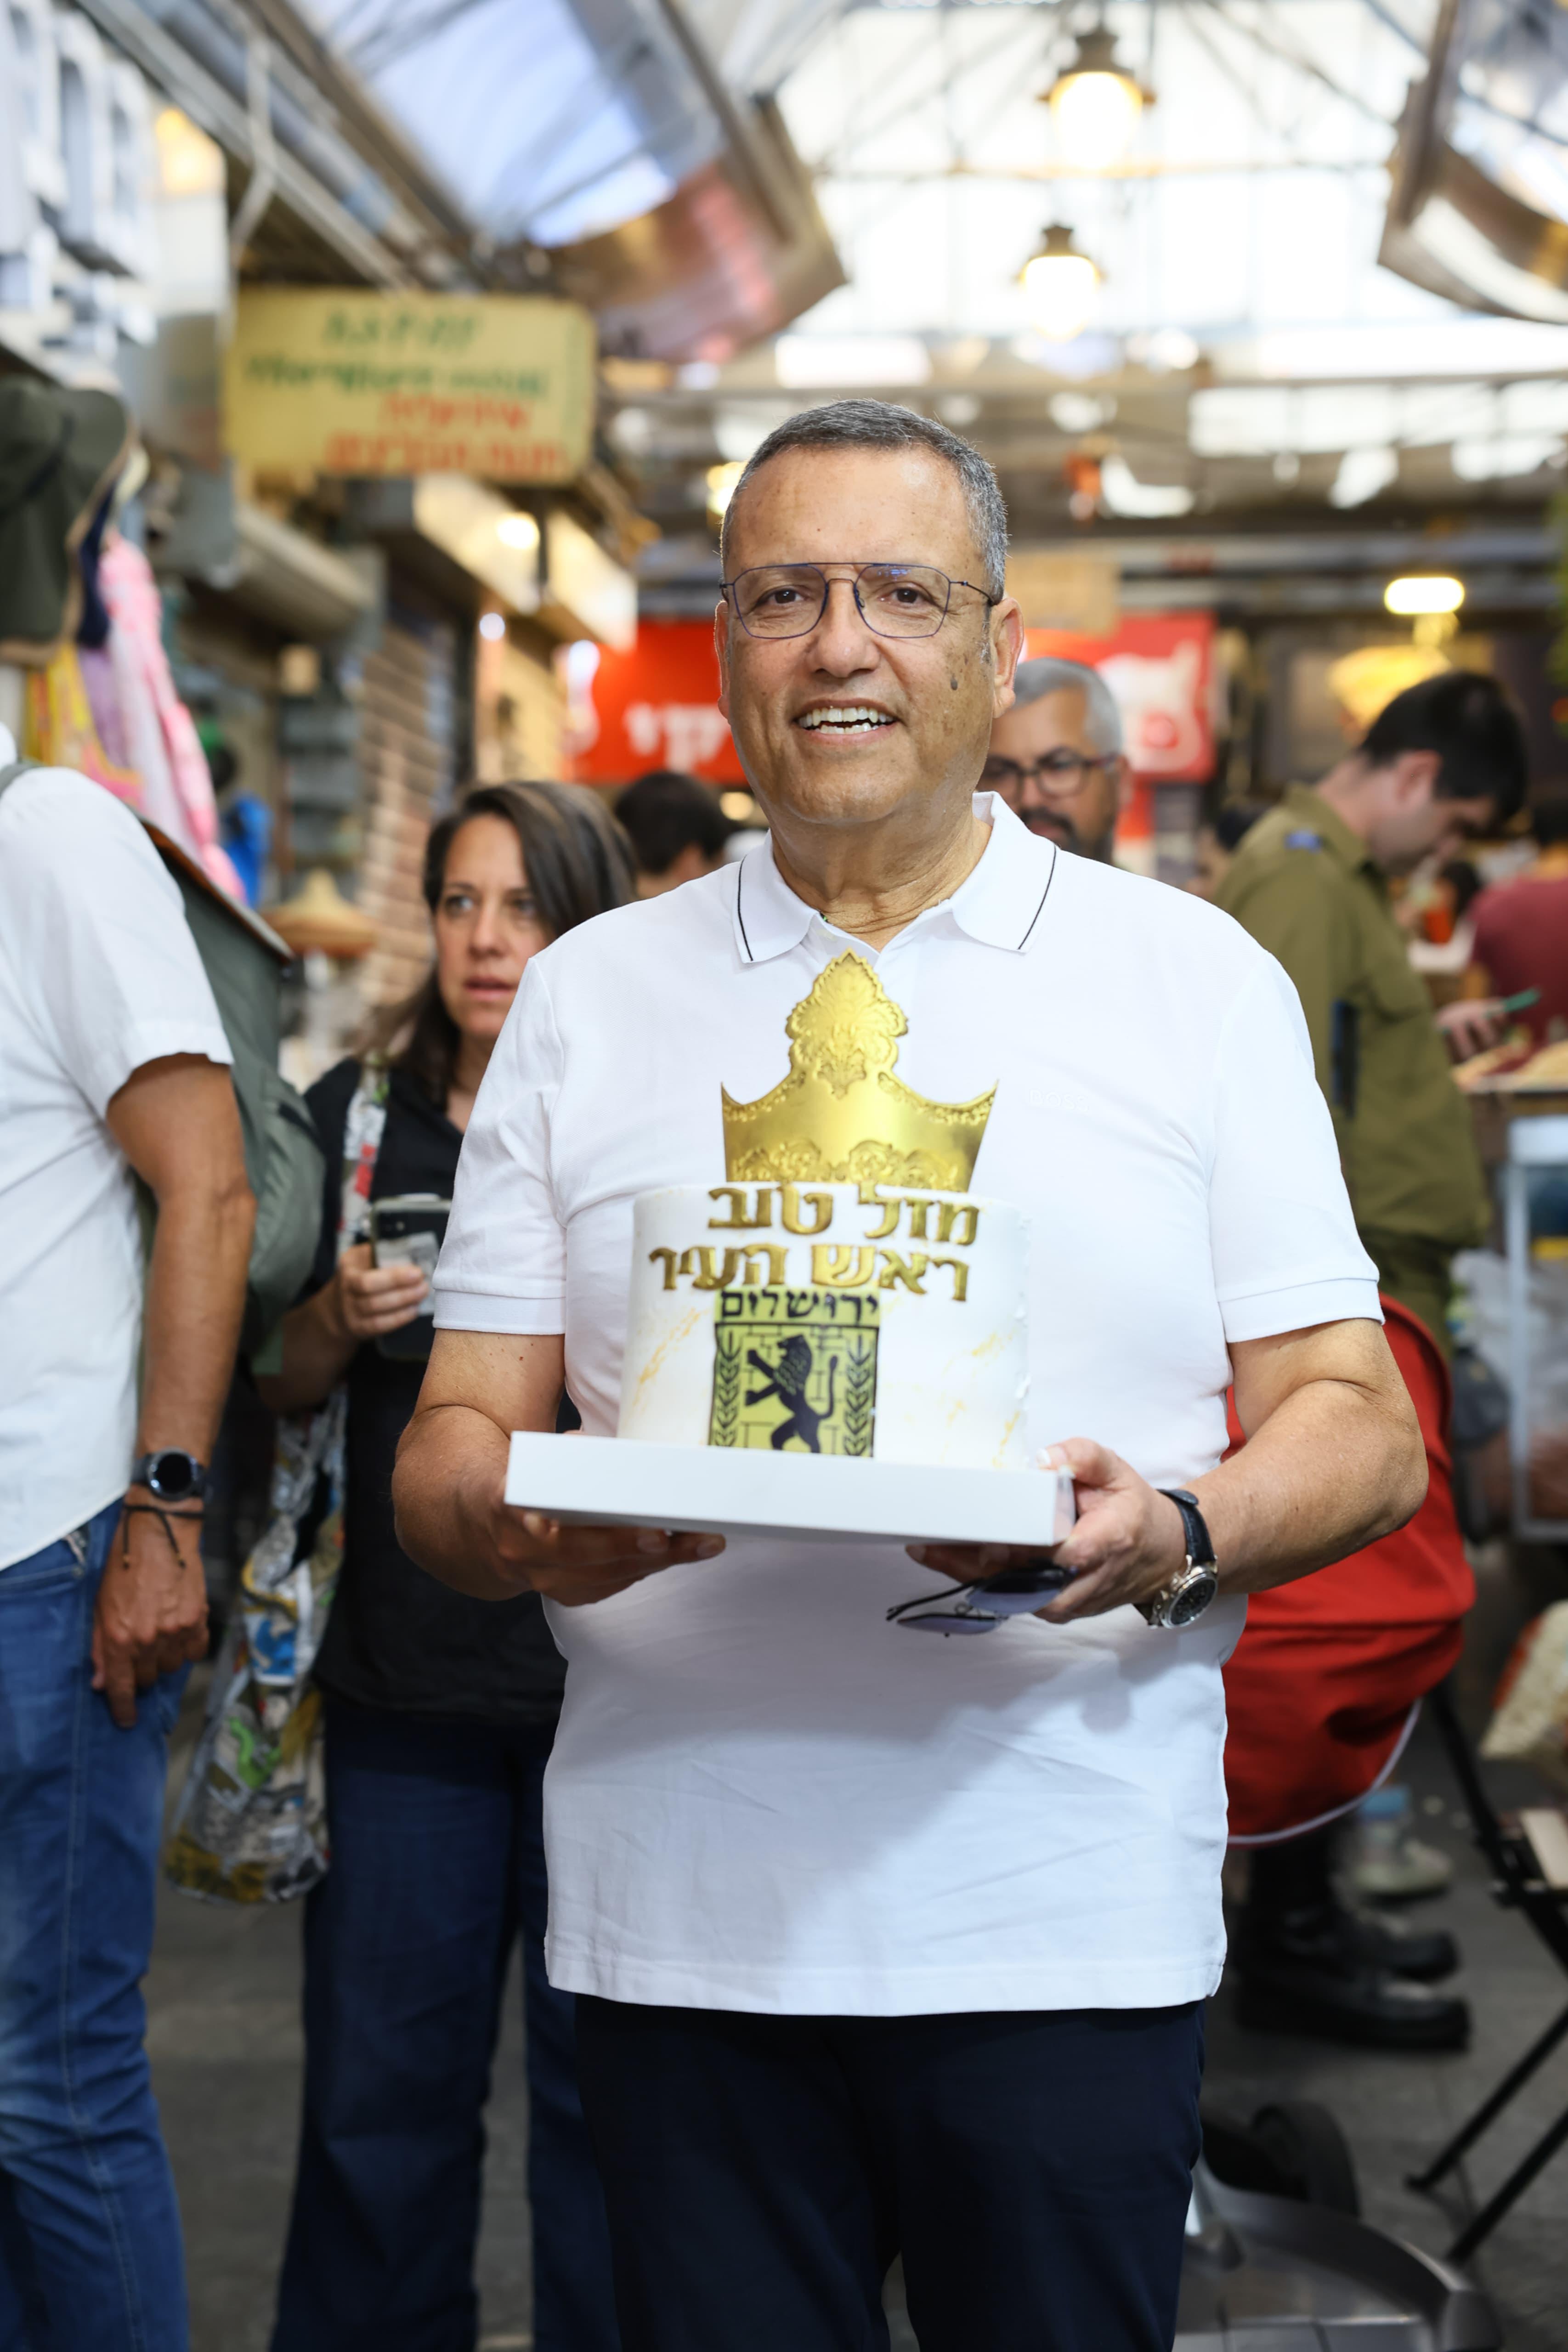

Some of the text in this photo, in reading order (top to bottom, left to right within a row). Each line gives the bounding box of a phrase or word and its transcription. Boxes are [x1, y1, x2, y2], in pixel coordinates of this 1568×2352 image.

[1030, 1089, 1090, 1114] BOSS
[708, 1180, 979, 1245] מזל טוב
[649, 1244, 970, 1301] ראש העיר
[721, 1290, 878, 1324] ירושלים
